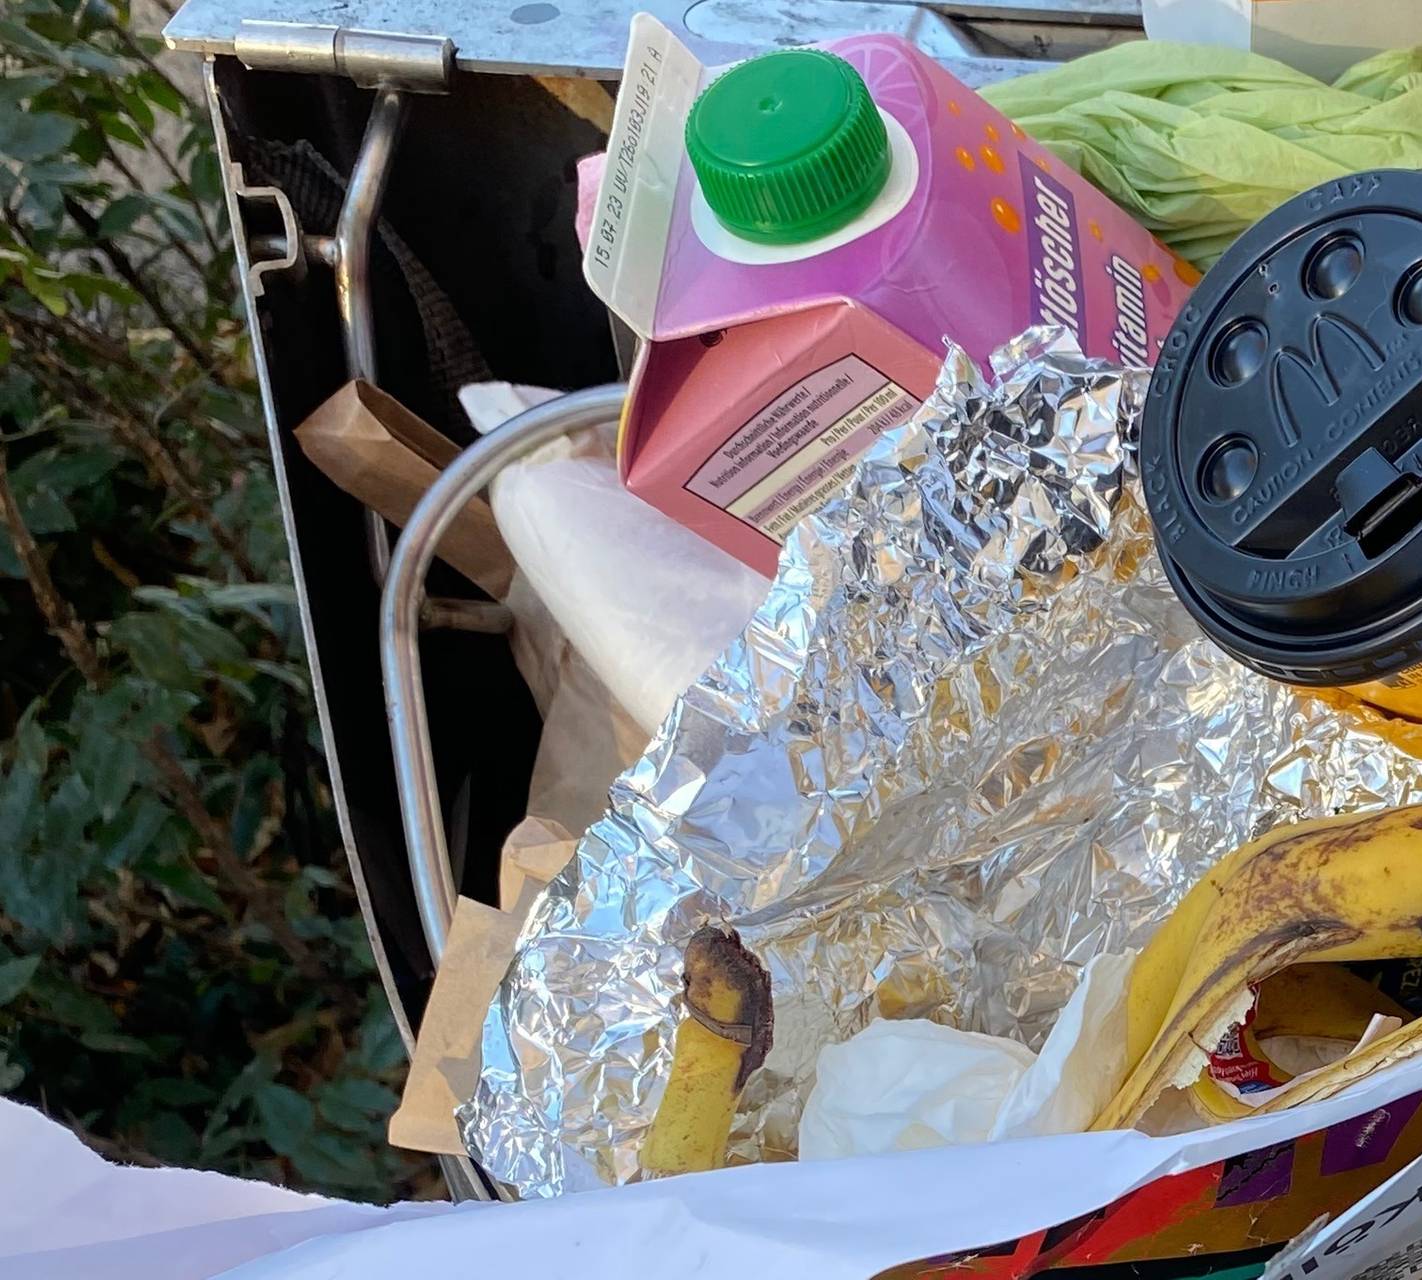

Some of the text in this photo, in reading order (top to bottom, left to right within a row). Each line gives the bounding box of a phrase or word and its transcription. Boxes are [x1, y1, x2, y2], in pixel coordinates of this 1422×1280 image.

[1034, 175, 1078, 339] tlöscher
[1106, 255, 1149, 368] vitamin
[1155, 306, 1202, 399] CHOC
[1230, 445, 1316, 527] CAUTION
[1325, 352, 1421, 443] CONTENTS
